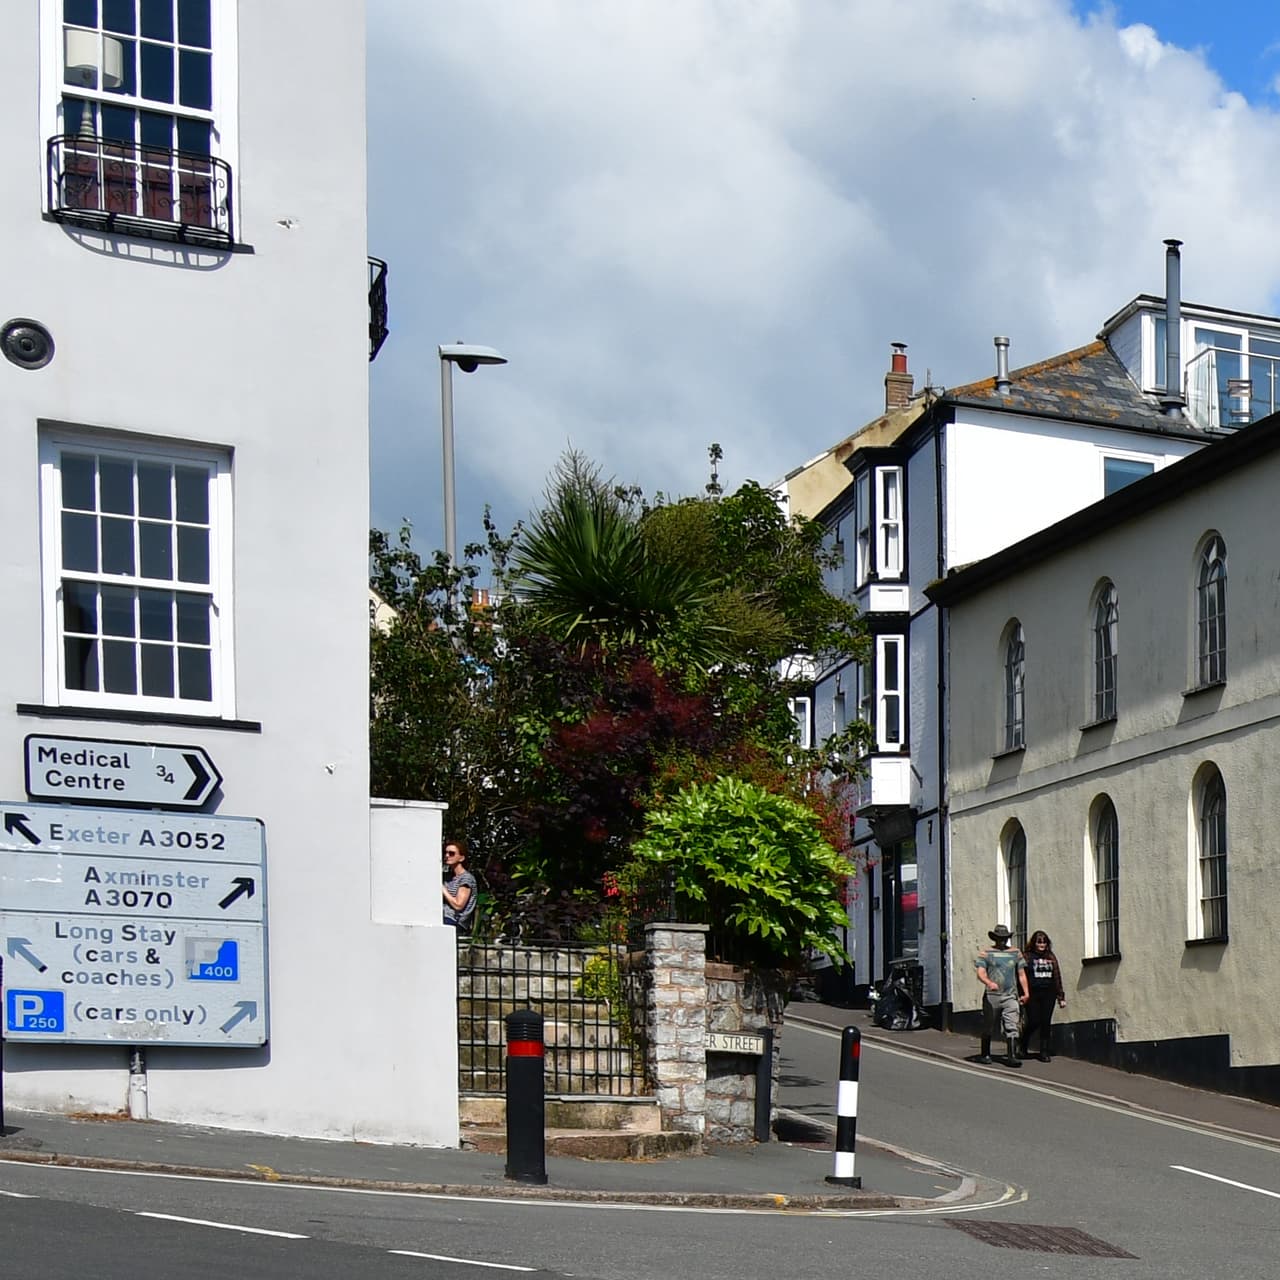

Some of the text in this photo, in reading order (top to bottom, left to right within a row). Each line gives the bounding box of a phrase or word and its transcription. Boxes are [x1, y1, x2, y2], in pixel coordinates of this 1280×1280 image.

[38, 746, 130, 769] Medical
[46, 770, 125, 791] Centre
[50, 824, 225, 850] Exeter A3052
[84, 867, 209, 889] Axminster
[84, 890, 173, 908] A3070
[55, 922, 176, 945] Long Stay
[73, 944, 160, 964] (cars &
[61, 969, 174, 989] coaches)
[204, 966, 233, 977] 400
[15, 994, 44, 1027] P
[73, 1001, 207, 1025] (cars only)
[29, 1018, 57, 1029] 250
[722, 1036, 760, 1051] STREET
